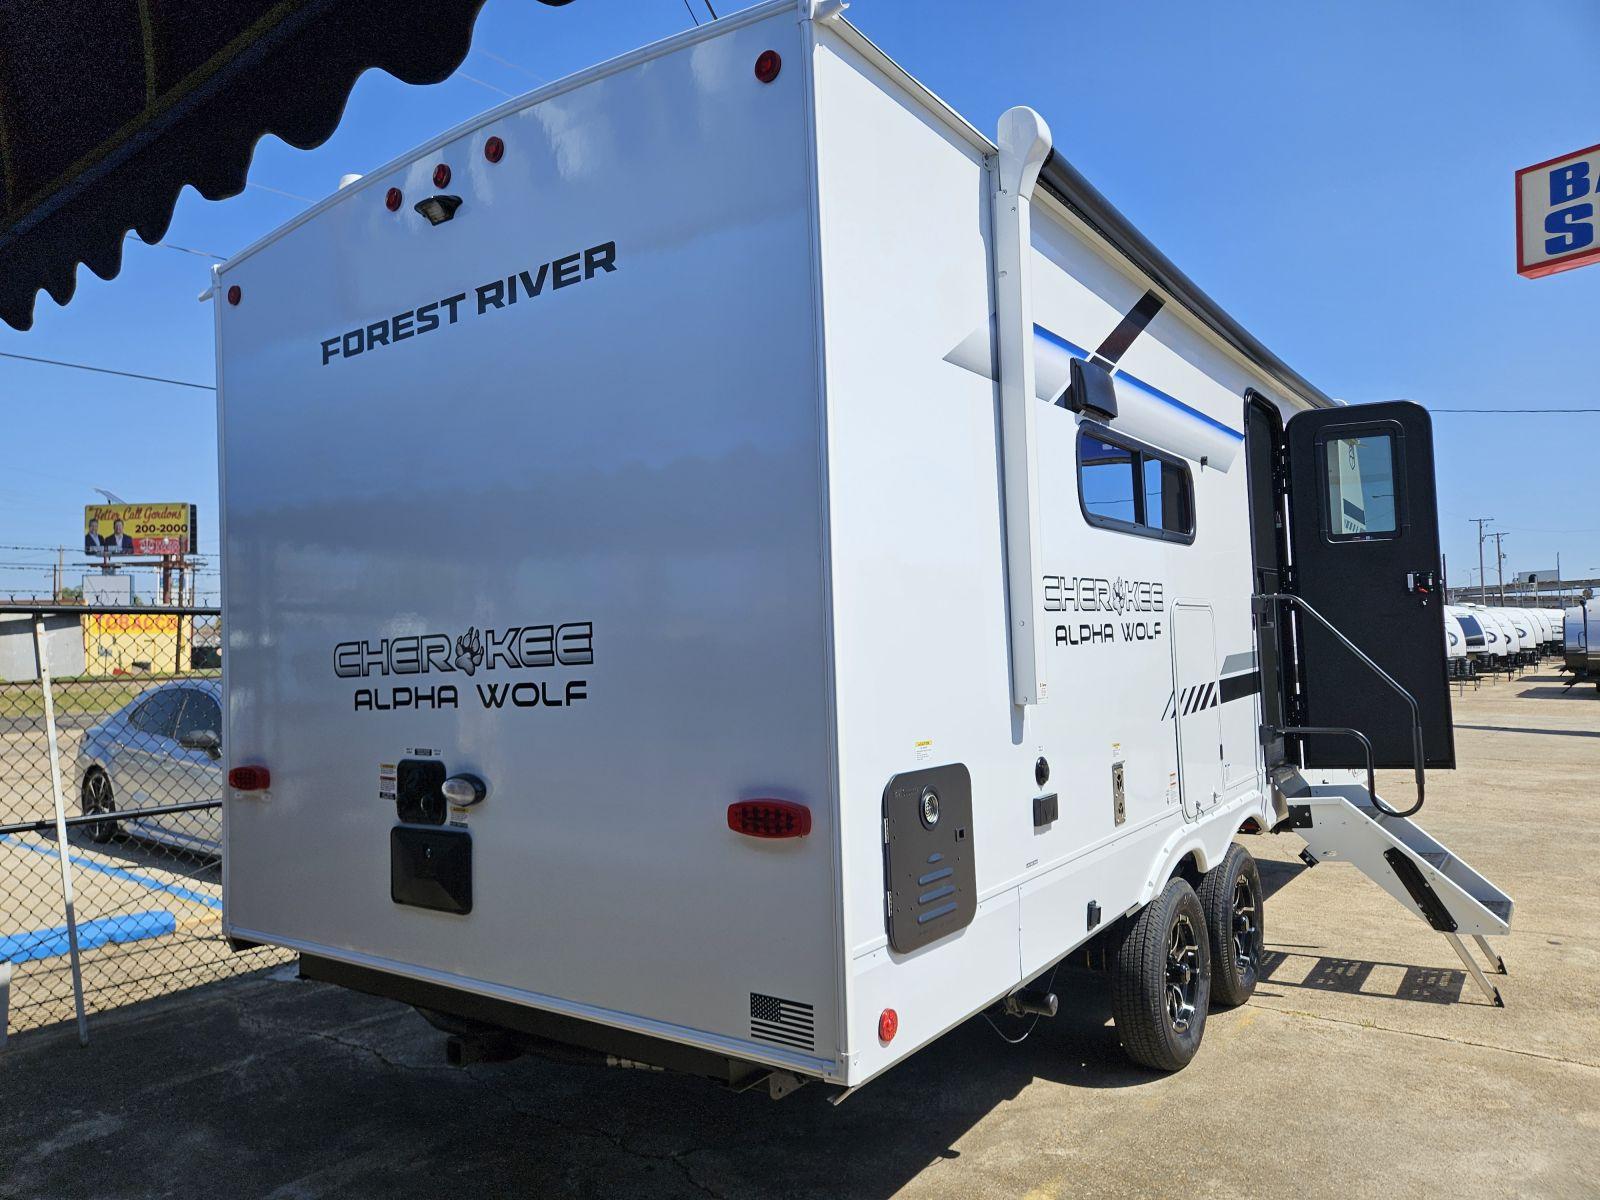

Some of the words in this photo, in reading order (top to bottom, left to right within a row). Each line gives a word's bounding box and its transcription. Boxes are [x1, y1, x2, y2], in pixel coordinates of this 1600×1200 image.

[1549, 161, 1600, 206] B
[320, 292, 466, 366] FOREST
[475, 240, 617, 315] RIVER
[123, 507, 143, 521] Call
[135, 524, 188, 533] 200-2000
[1055, 623, 1115, 646] ALPHA
[1120, 621, 1162, 642] WOLF
[354, 685, 459, 711] ALPHA
[476, 680, 588, 708] WOLF
